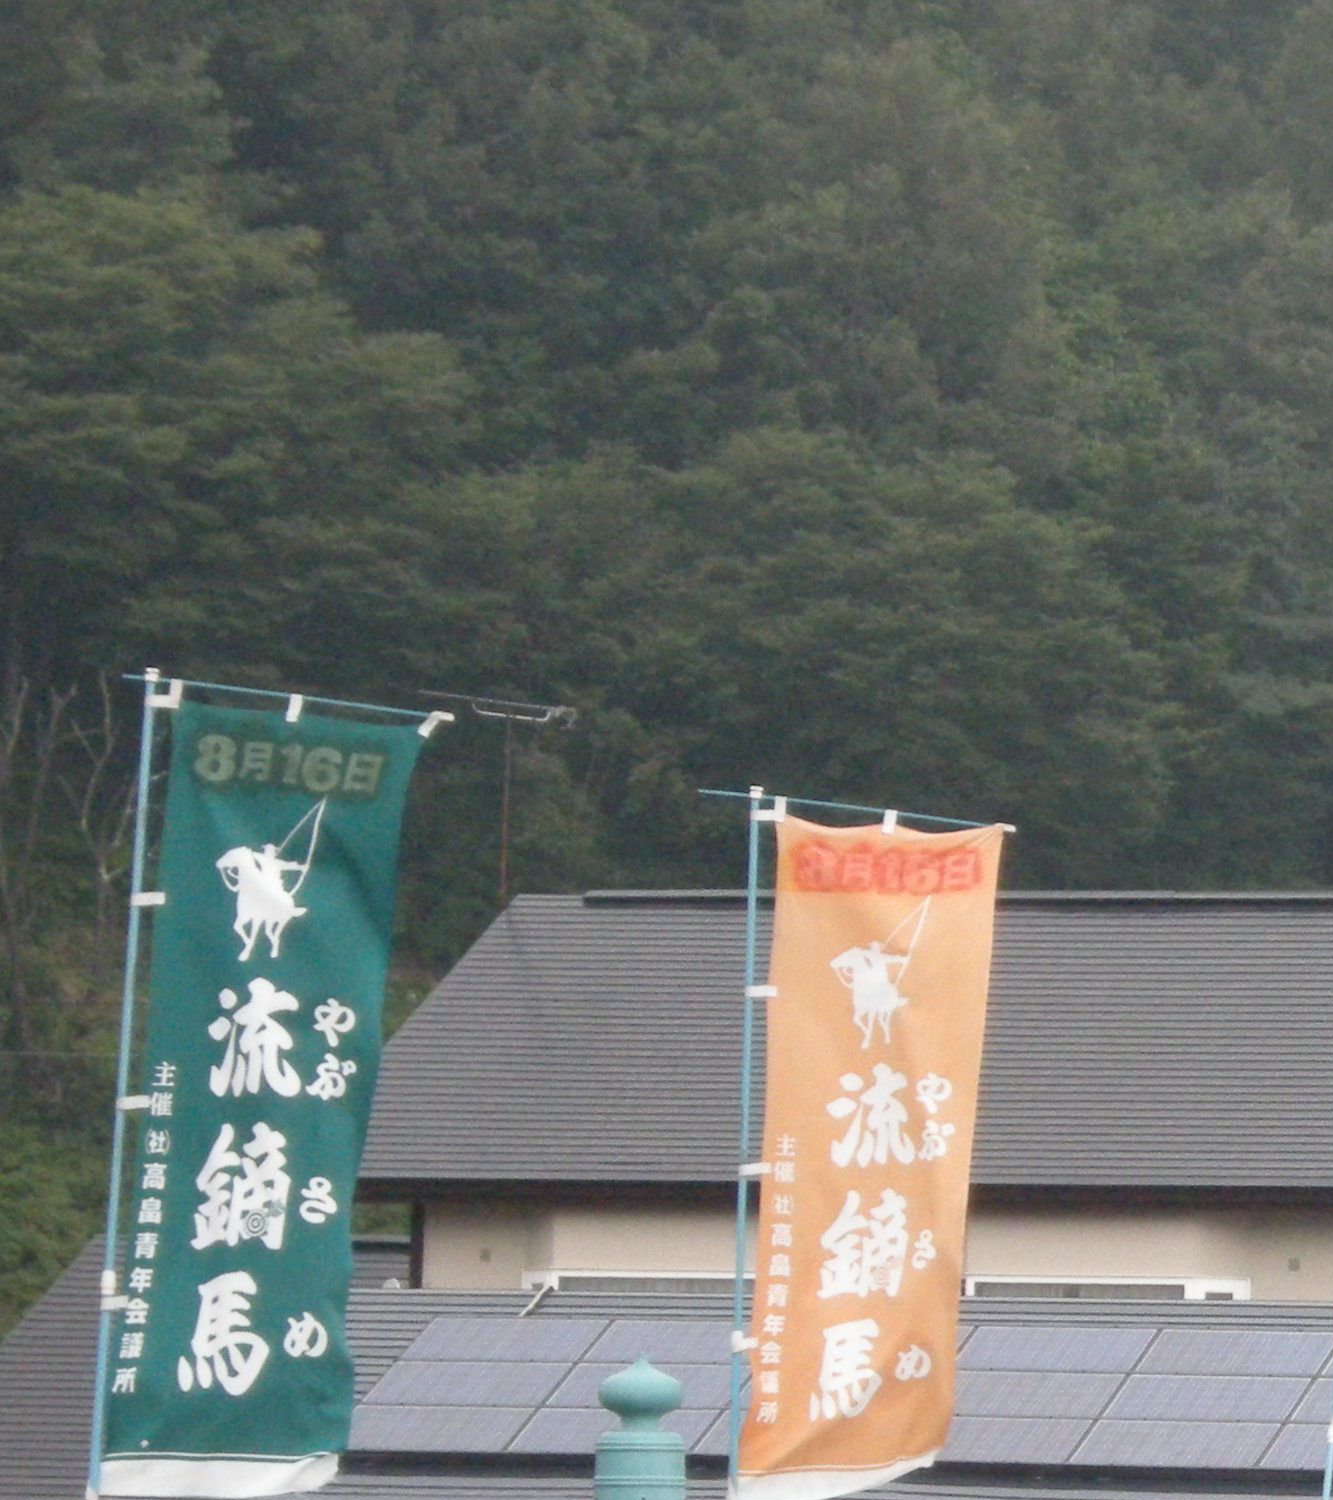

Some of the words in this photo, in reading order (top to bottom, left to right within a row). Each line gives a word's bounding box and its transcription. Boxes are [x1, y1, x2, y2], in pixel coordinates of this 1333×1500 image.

[193, 733, 384, 796] 8月16日
[178, 975, 302, 1397] 流鏑馬
[810, 1061, 916, 1422] 流鏑馬
